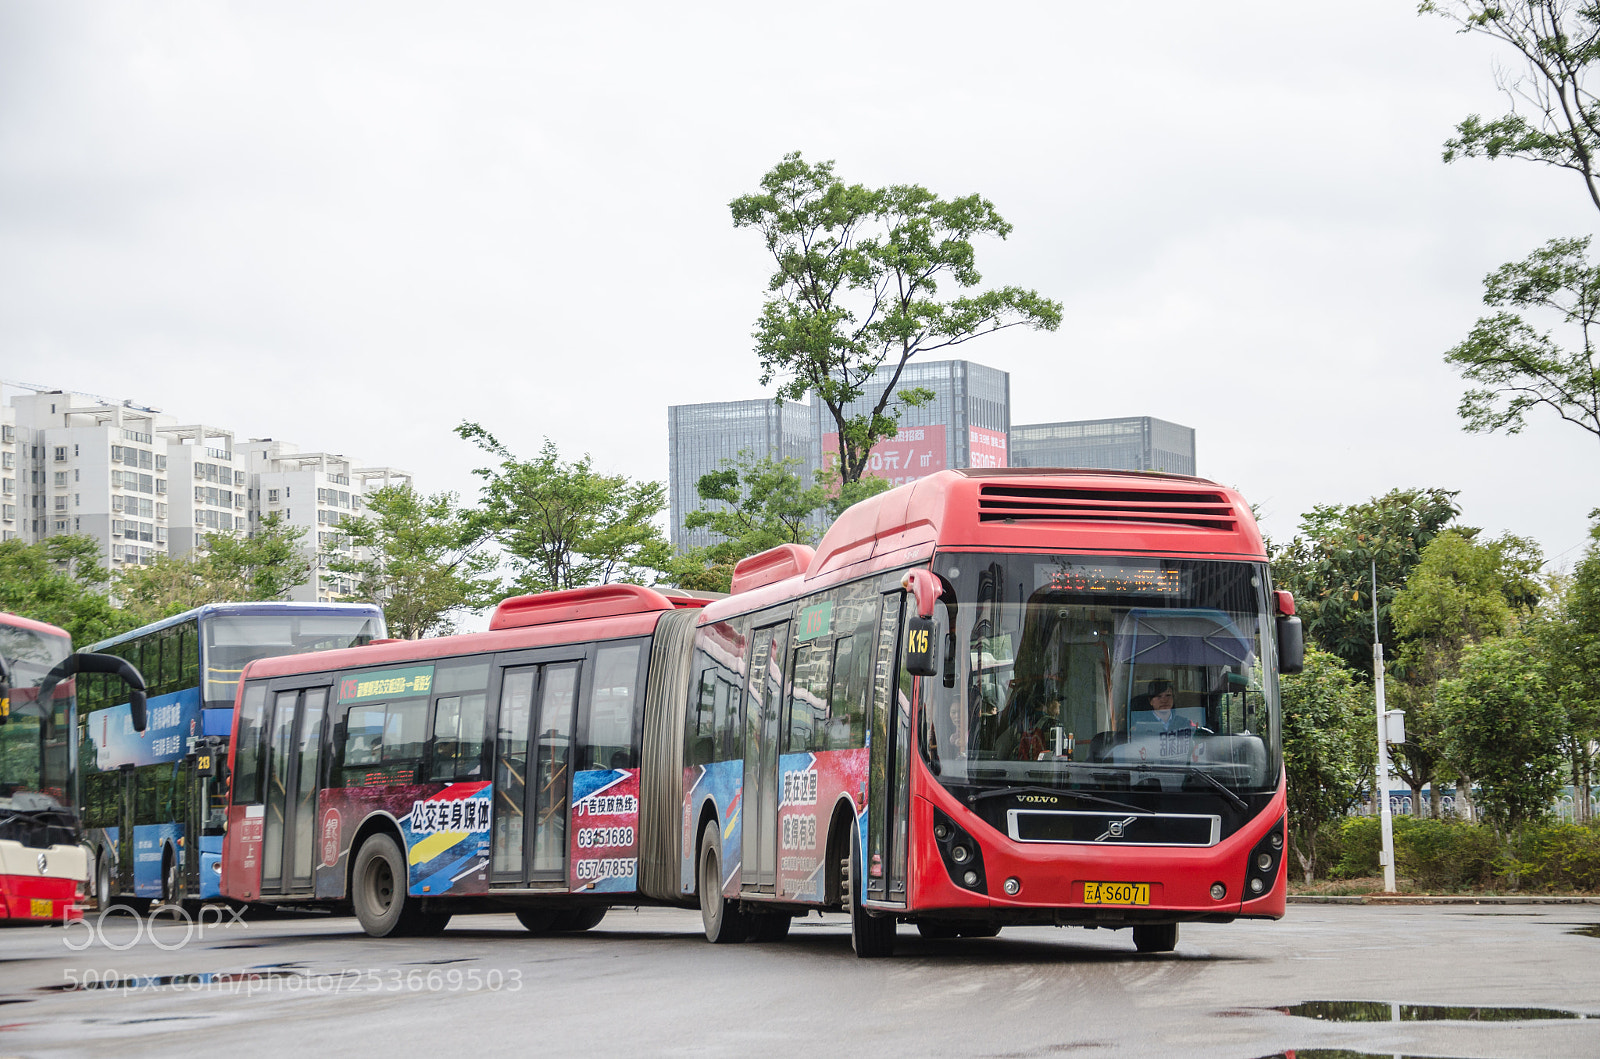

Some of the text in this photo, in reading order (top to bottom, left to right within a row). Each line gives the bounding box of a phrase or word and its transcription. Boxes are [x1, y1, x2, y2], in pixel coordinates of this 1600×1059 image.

[806, 609, 823, 634] K15
[908, 630, 929, 653] K15
[340, 679, 358, 699] K15
[784, 772, 818, 804] 我在这里
[1016, 795, 1058, 804] VOLVO
[412, 800, 490, 832] 公交车身媒体
[577, 859, 635, 878] 65747855
